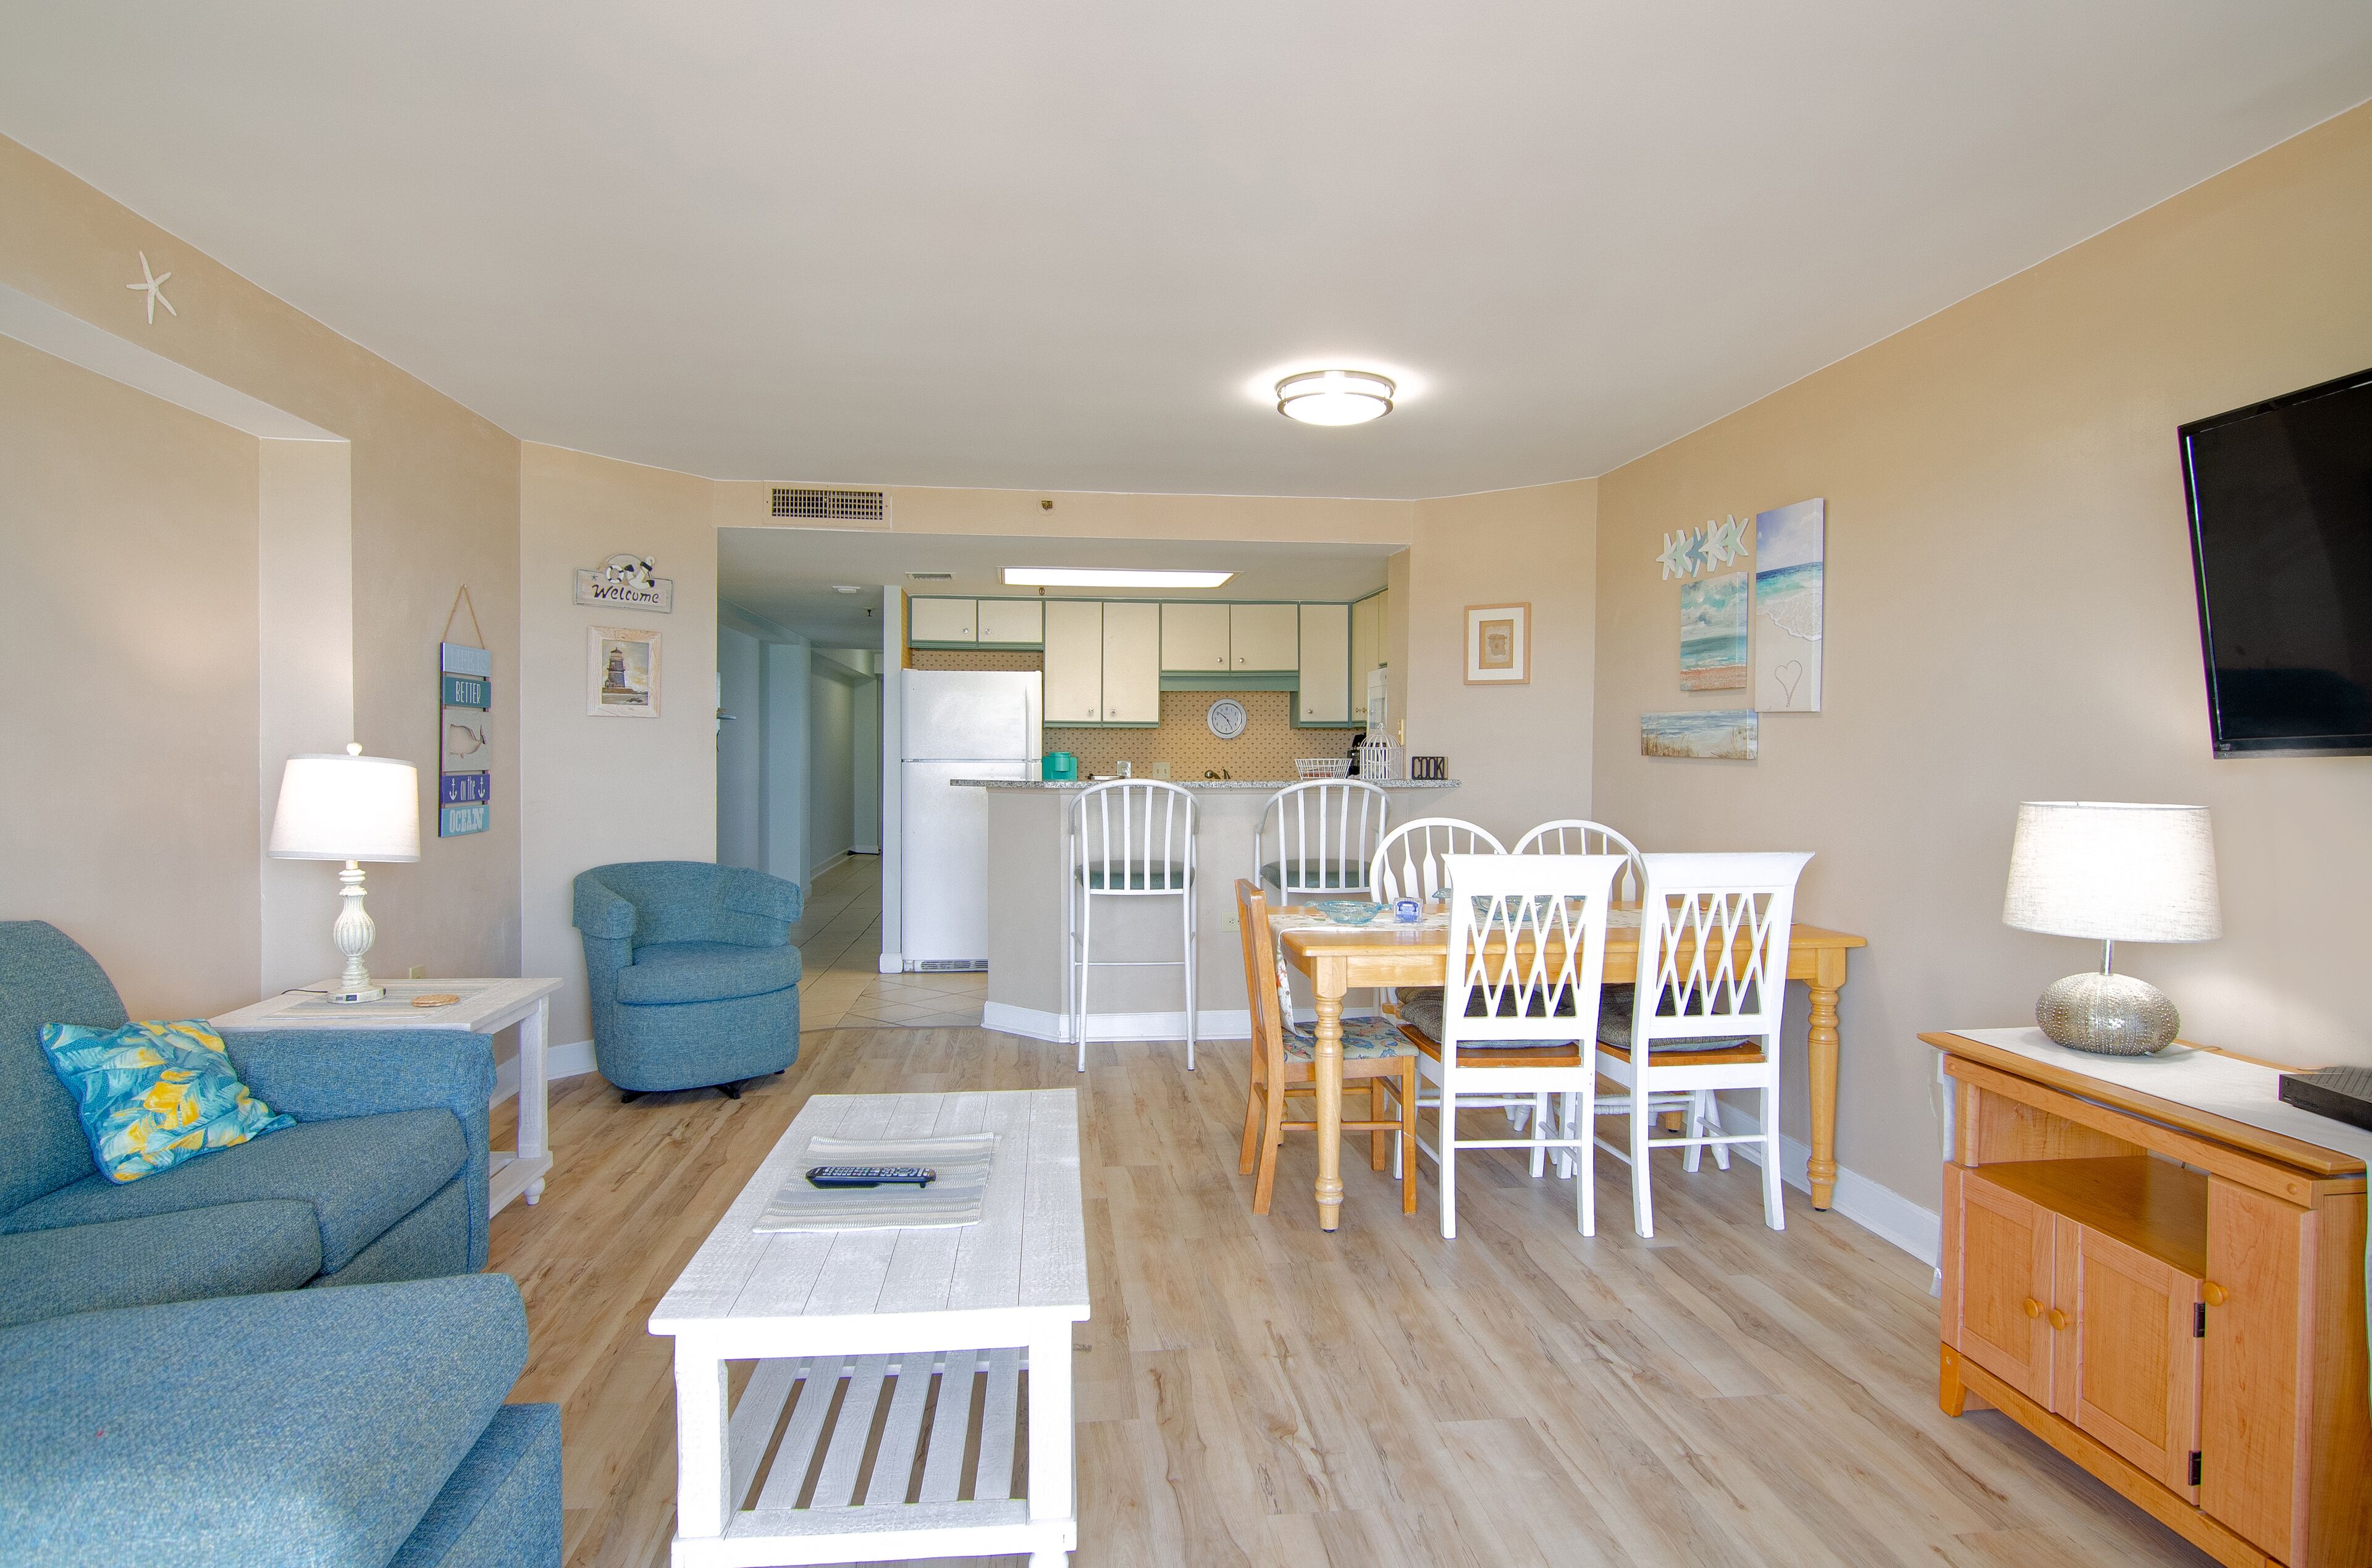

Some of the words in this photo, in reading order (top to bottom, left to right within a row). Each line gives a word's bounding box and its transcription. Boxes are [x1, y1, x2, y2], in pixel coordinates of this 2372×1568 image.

[592, 584, 659, 603] Welcome
[450, 648, 474, 671] LIFE
[477, 652, 487, 673] IS
[455, 681, 481, 704] BETTER
[1412, 757, 1444, 780] COOK
[468, 776, 476, 800] the
[450, 807, 484, 833] OCEAN
